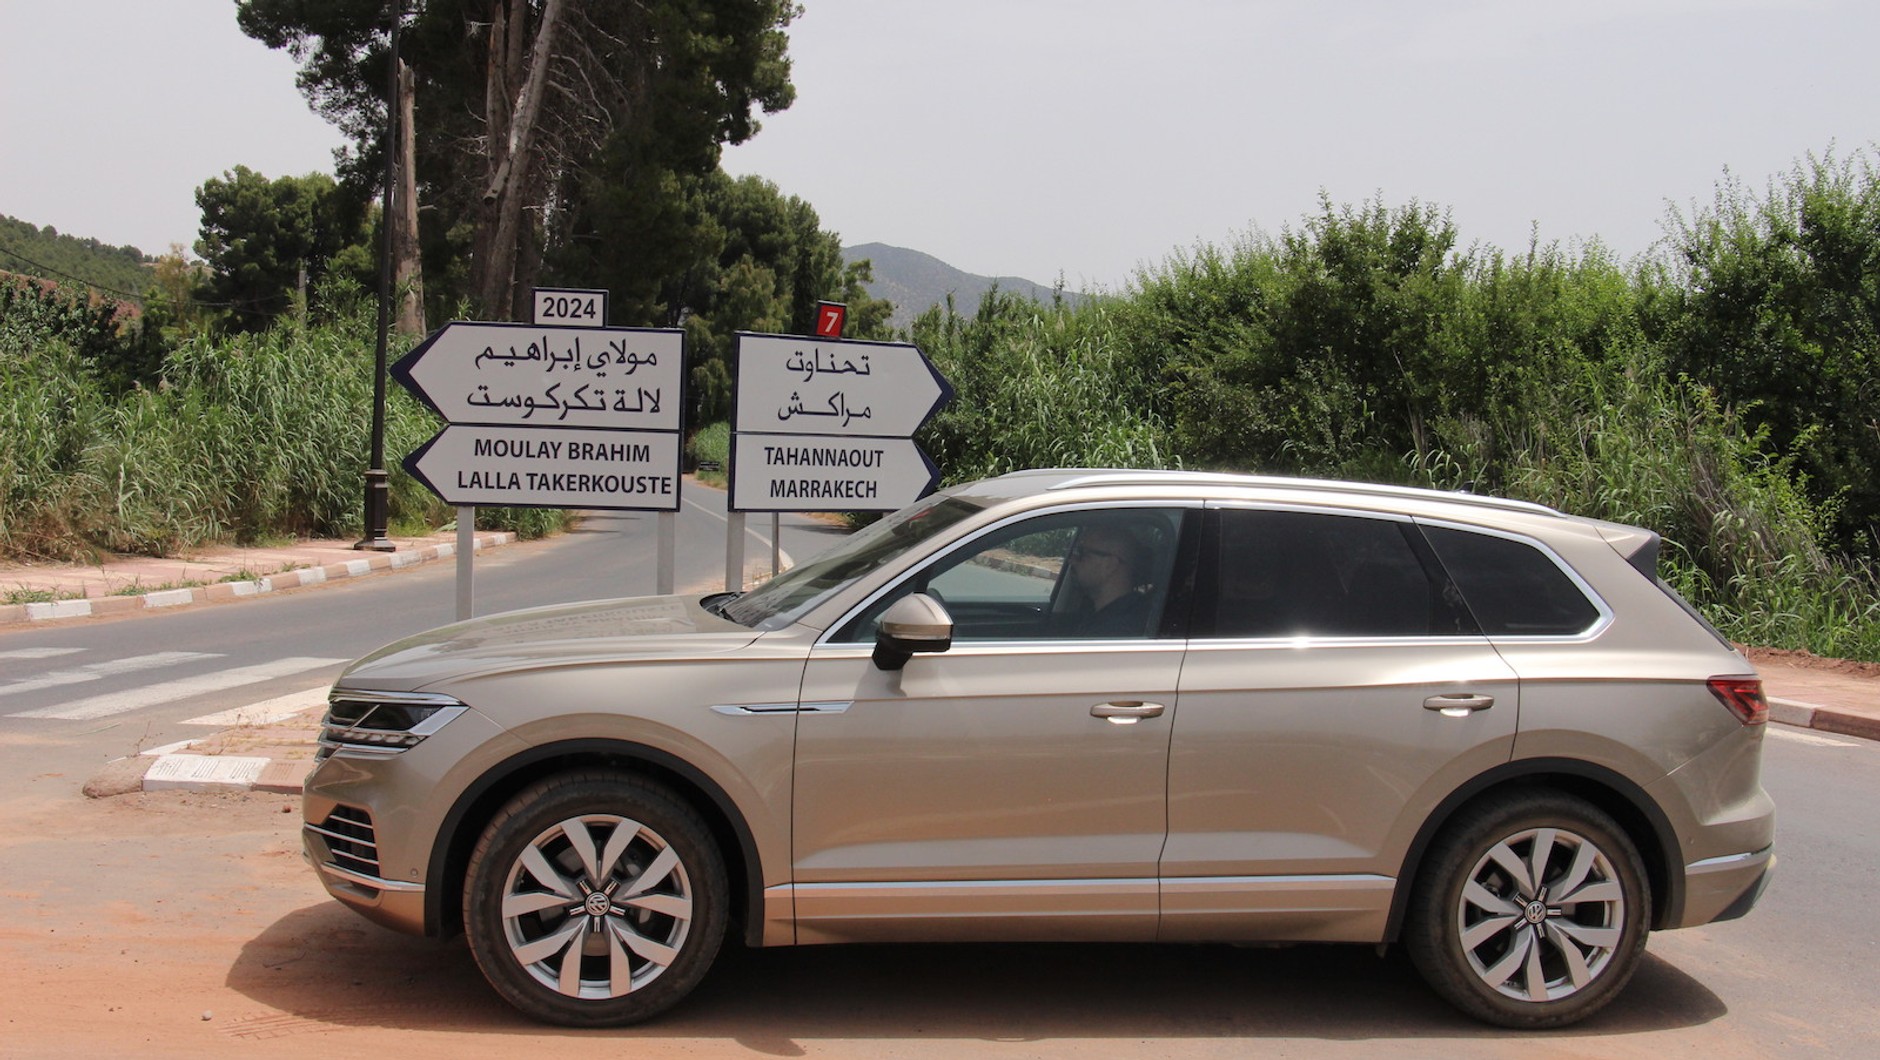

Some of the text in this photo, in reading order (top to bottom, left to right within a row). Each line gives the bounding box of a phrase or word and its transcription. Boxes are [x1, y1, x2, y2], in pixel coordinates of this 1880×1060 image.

[542, 297, 596, 319] 2024
[824, 312, 839, 332] 7
[475, 335, 658, 378] مولاي إبراهيم
[786, 348, 870, 382] تحناوت
[467, 382, 661, 421] لالة تكركوست
[777, 391, 872, 427] مراكش
[474, 438, 651, 463] MOULAY BRAHIM
[764, 447, 885, 468] TAHANNAOUT
[457, 470, 672, 495] LALLA TAKERKOUSTE
[770, 479, 878, 499] MARRAKECH
